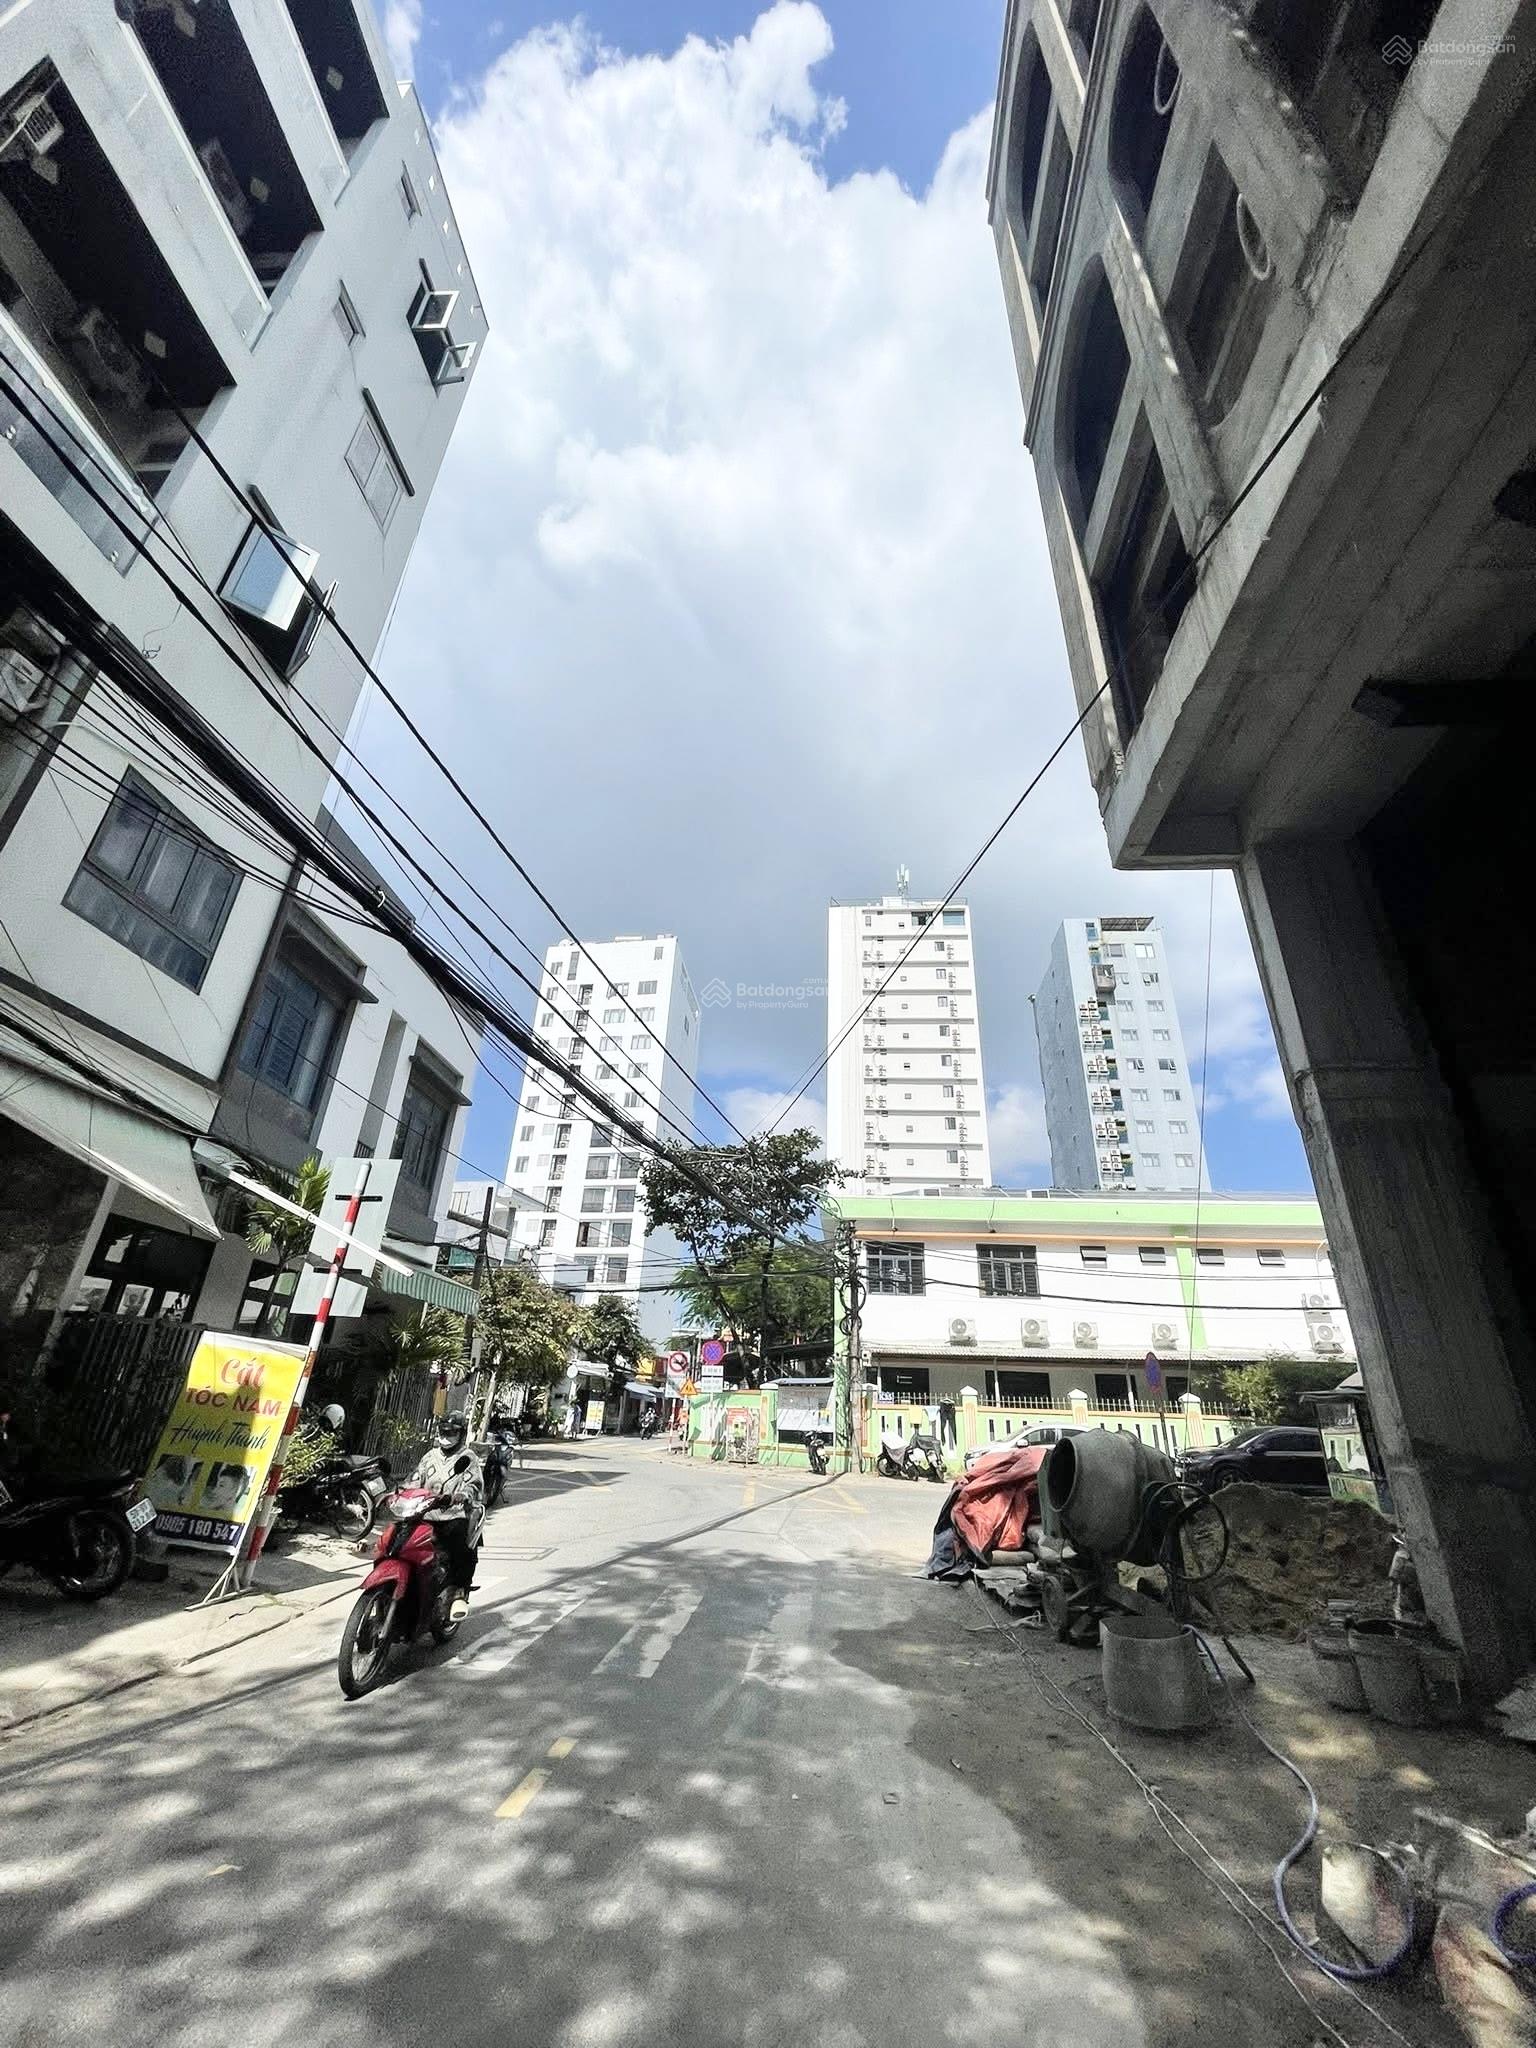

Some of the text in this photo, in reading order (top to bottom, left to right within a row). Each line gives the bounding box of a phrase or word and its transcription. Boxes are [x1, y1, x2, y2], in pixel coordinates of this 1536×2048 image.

[184, 1385, 282, 1416] TÓC NAM
[155, 1513, 187, 1532] 0905
[188, 1519, 212, 1537] 180
[213, 1523, 239, 1540] 547
